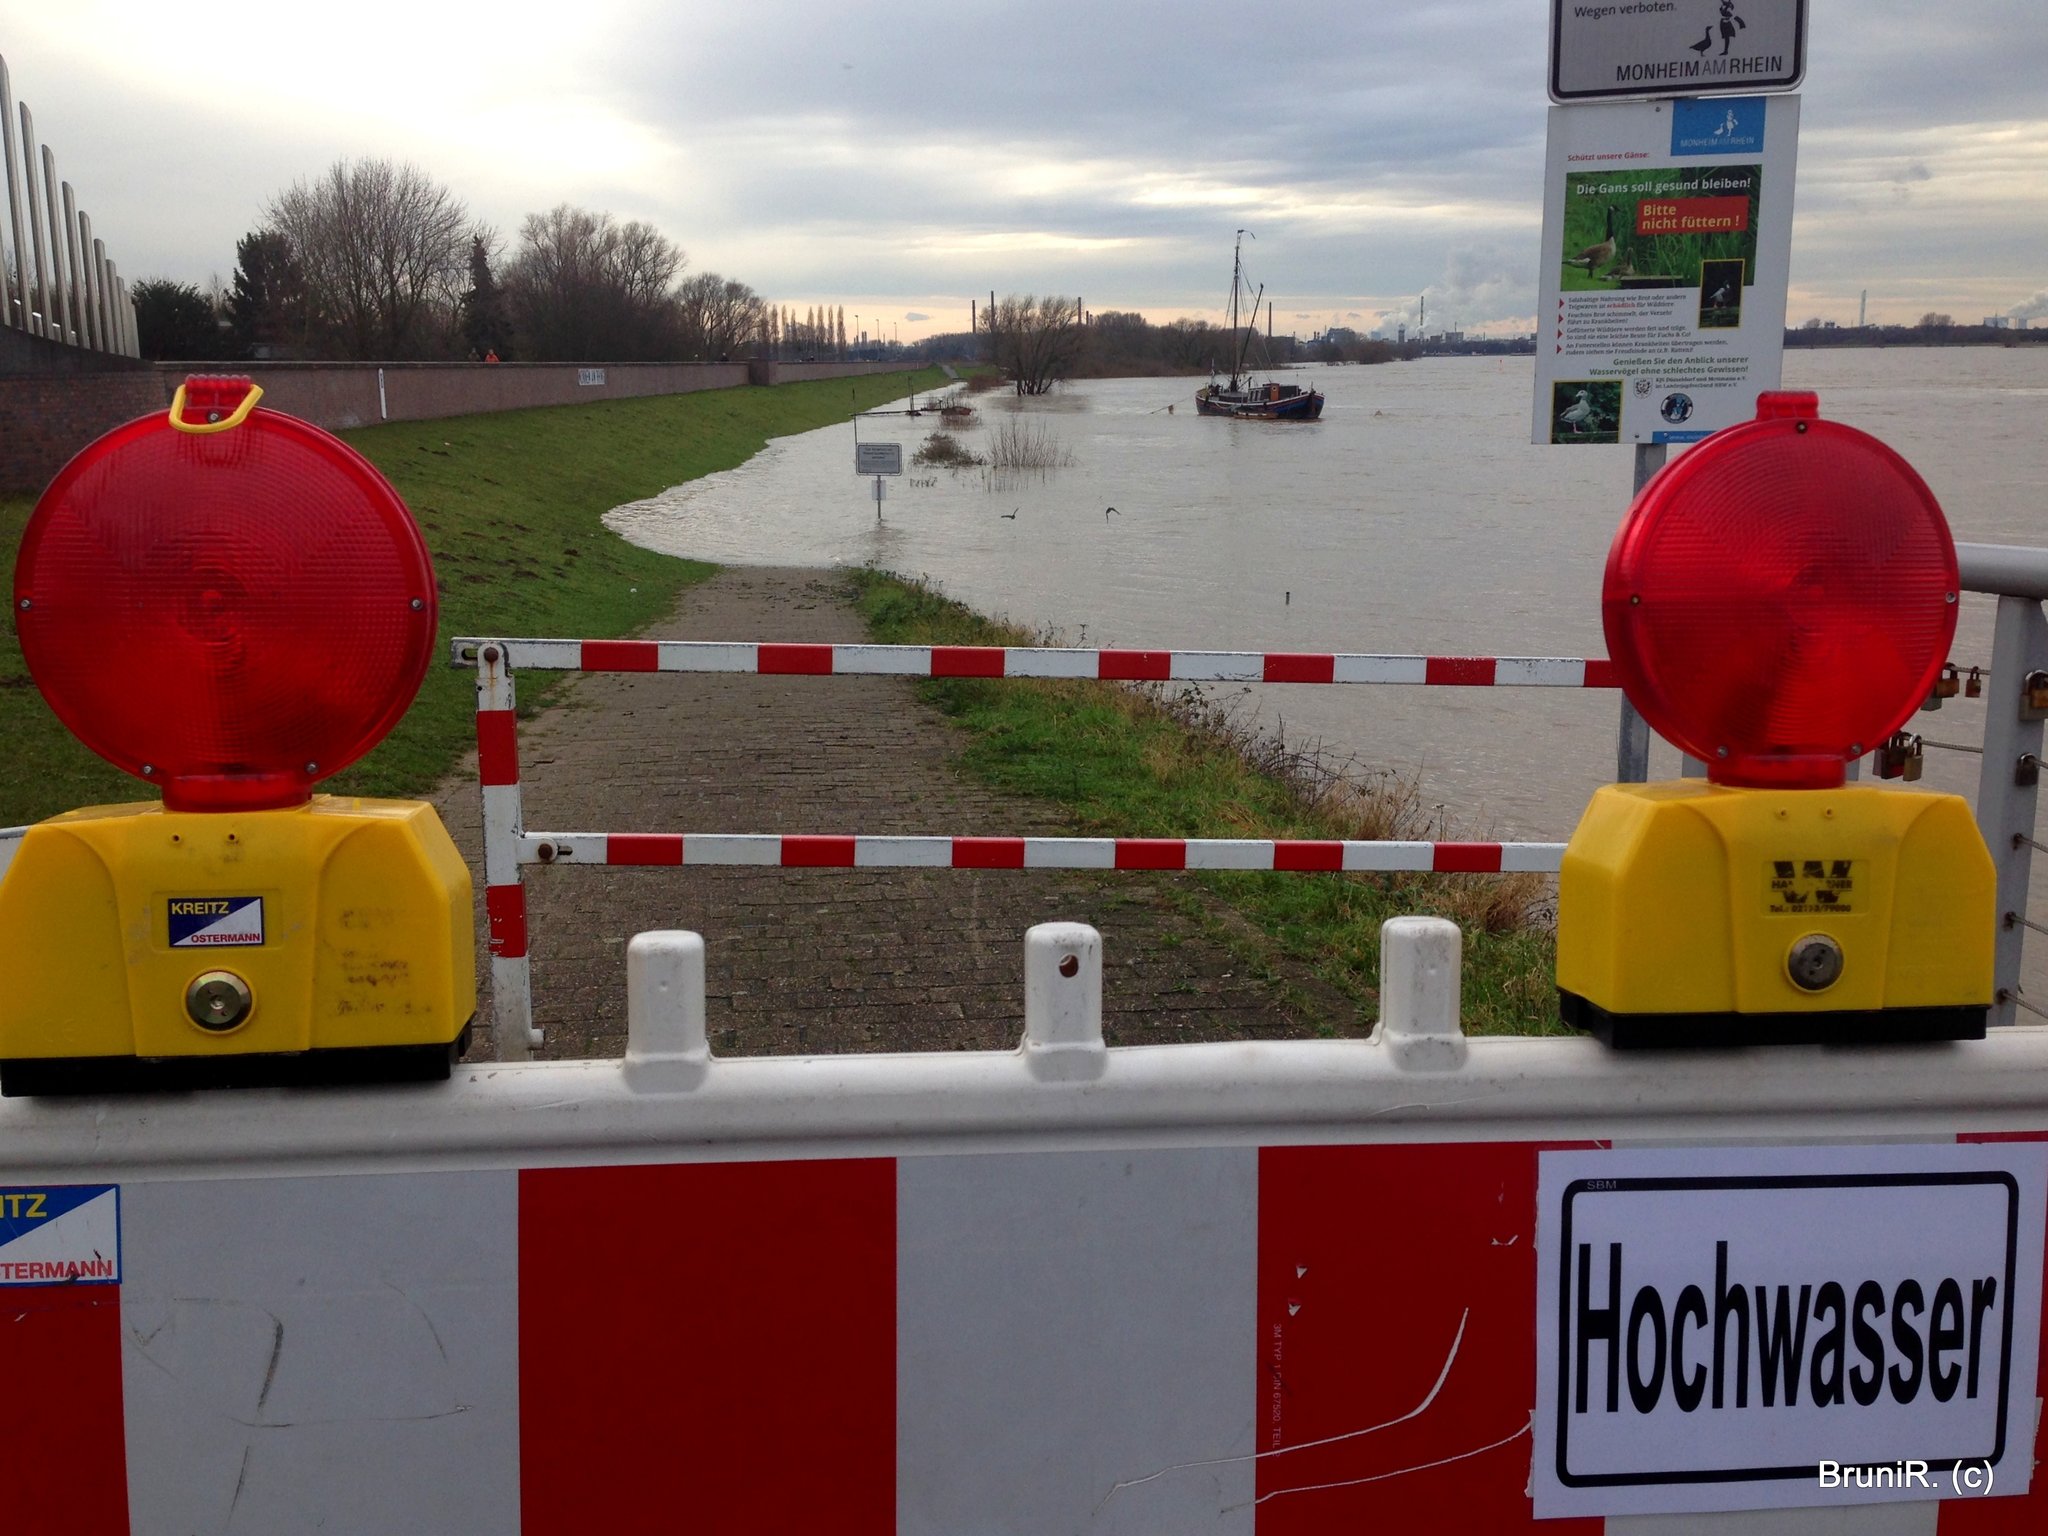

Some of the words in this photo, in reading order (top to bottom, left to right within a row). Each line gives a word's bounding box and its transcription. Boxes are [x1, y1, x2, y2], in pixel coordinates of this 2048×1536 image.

[1574, 6, 1616, 20] Wegen
[1619, 2, 1677, 15] verboten.
[1616, 60, 1699, 81] MONHEIM
[1702, 59, 1726, 76] AM
[1729, 56, 1782, 74] RHEIN
[1568, 153, 1594, 162] Schützt
[1576, 184, 1596, 194] Die
[1599, 183, 1628, 194] Gans
[1631, 181, 1652, 192] soll
[1654, 180, 1698, 194] gesund
[1702, 178, 1751, 189] bleiben!
[1643, 204, 1676, 216] Bitte
[1642, 216, 1677, 229] nicht
[1681, 216, 1731, 228] füttern
[1735, 215, 1740, 226] !
[1613, 357, 1652, 366] Genießen
[1668, 356, 1682, 364] den
[1590, 368, 1638, 376] Wasservögel
[1663, 366, 1706, 374] schlechtes
[172, 902, 229, 914] KREITZ
[191, 933, 260, 943] OSTERMANN
[1587, 1180, 1616, 1190] SBM
[1274, 1323, 1282, 1338] 3M
[1576, 1240, 1997, 1414] Hochwasser
[1274, 1342, 1282, 1360] TYP
[1272, 1426, 1282, 1448] TEIL
